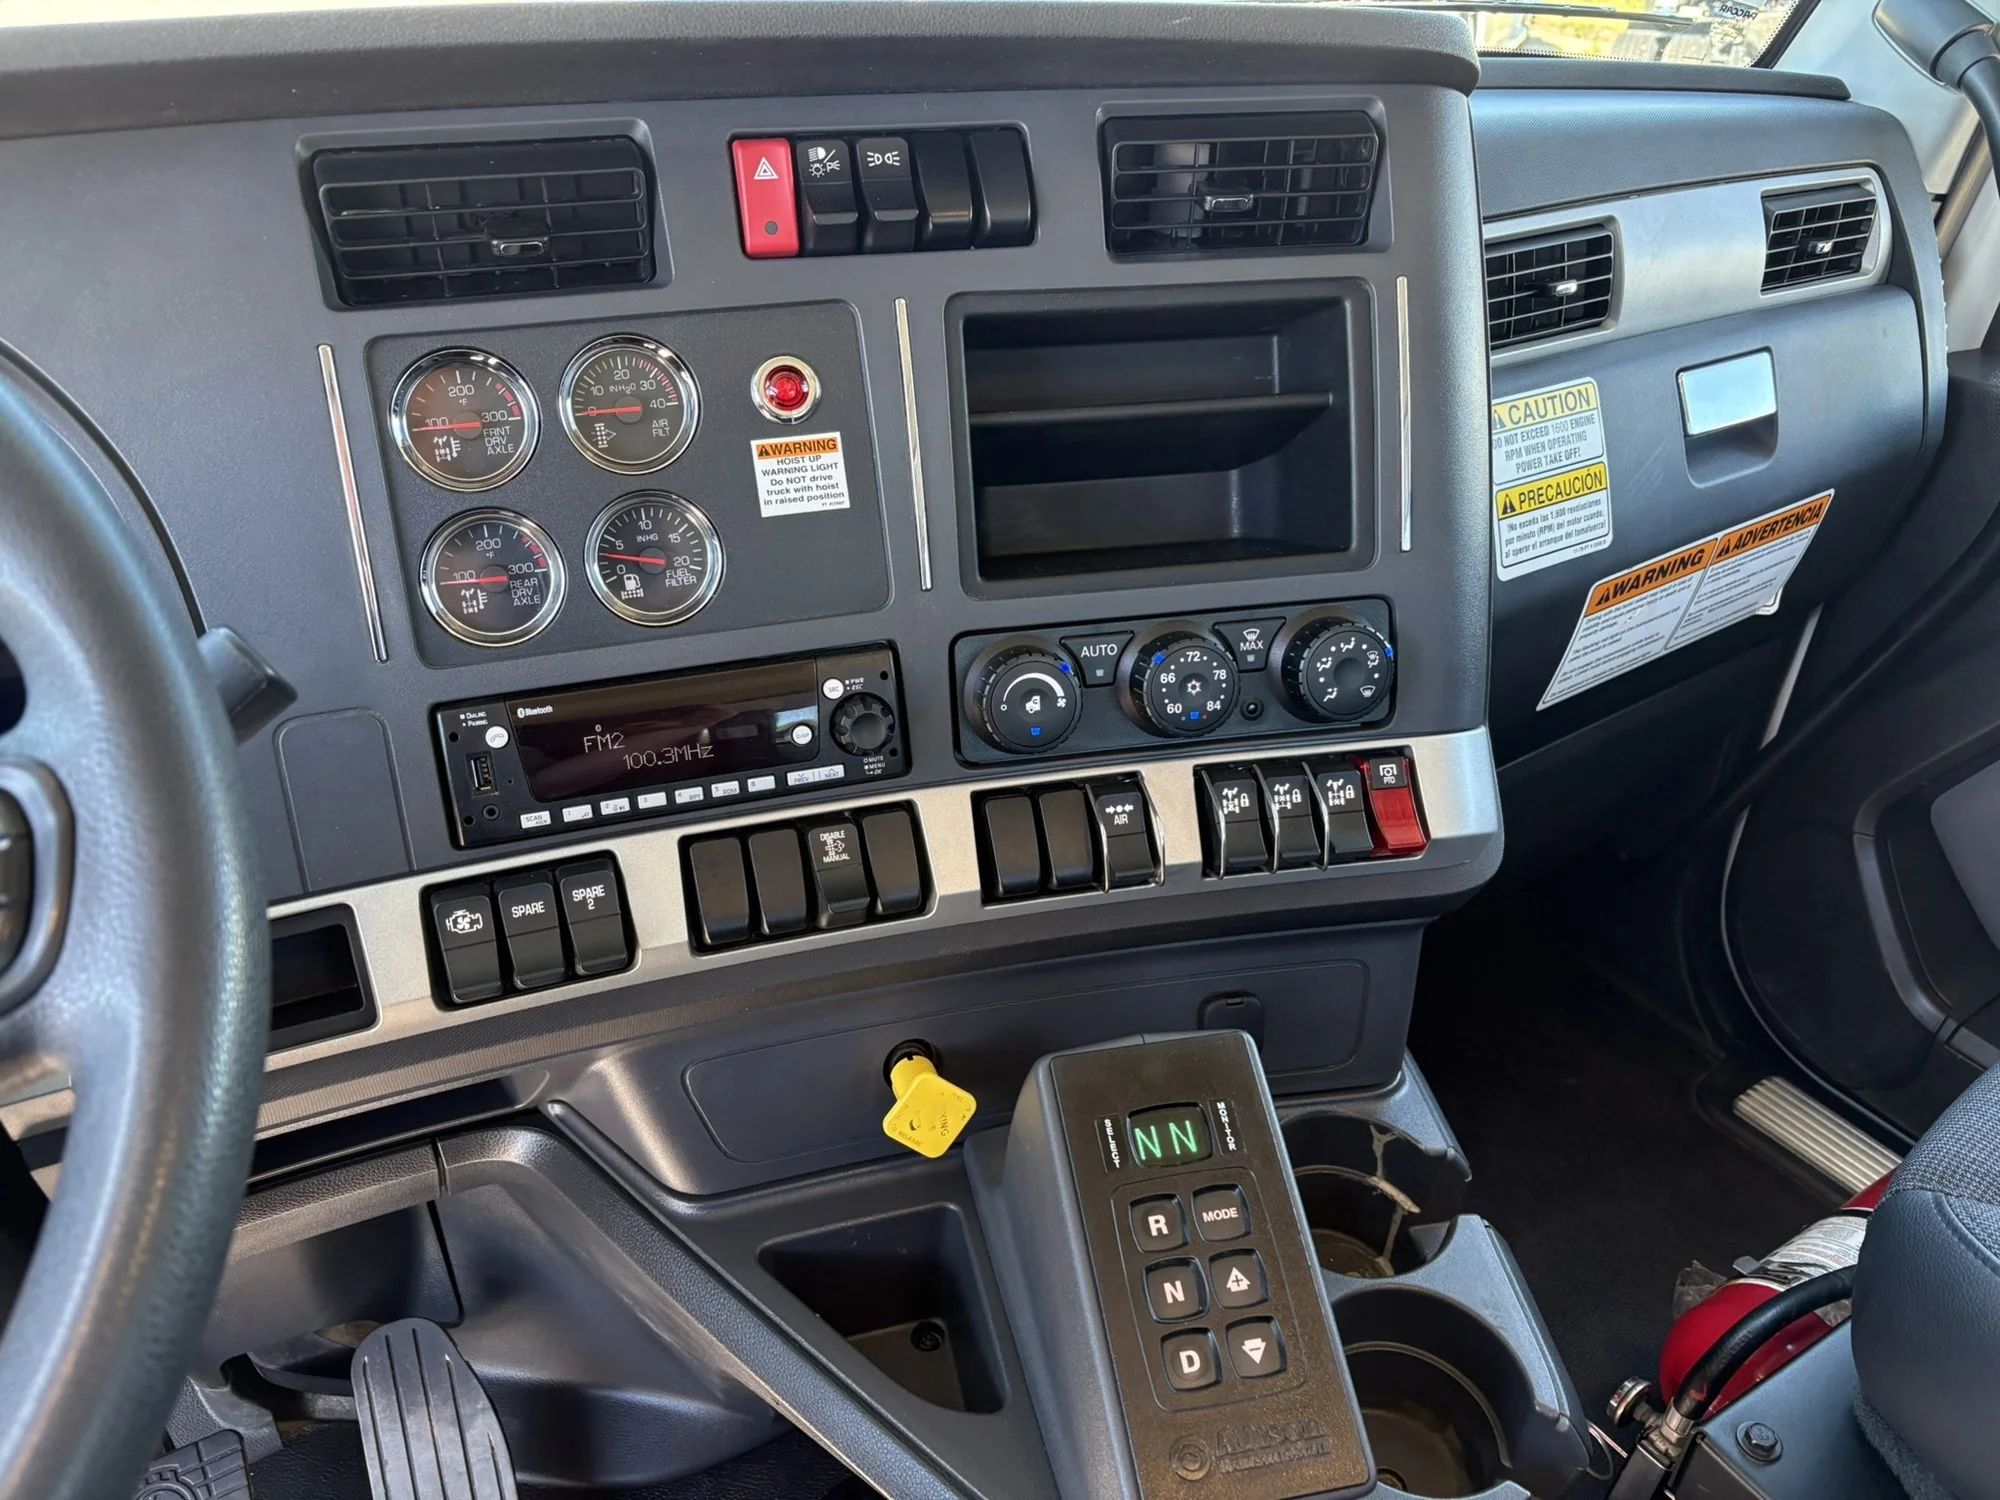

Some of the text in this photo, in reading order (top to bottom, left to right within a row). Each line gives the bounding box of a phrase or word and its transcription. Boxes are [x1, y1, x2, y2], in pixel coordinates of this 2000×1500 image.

[614, 369, 630, 381] 20
[447, 384, 475, 397] 200
[590, 385, 604, 396] 10
[640, 380, 656, 391] 30
[649, 398, 666, 409] 40
[1507, 386, 1591, 426] CAUTION
[425, 416, 449, 427] 100
[481, 410, 508, 423] 300
[652, 419, 669, 428] AIR
[483, 426, 511, 437] FRNT
[652, 427, 671, 437] FILT
[1504, 432, 1519, 447] NOT
[1521, 425, 1549, 442] EXCEED
[1570, 413, 1596, 430] ENGINE
[484, 436, 508, 447] DRV
[769, 438, 837, 456] WARNING
[1504, 430, 1587, 462] RPM WHEN OPERATING
[486, 444, 515, 456] AXLE
[776, 455, 822, 466] HOIST UP
[1516, 447, 1581, 474] POWER TAKE OFF!
[761, 462, 839, 477] WARNING LIGHT
[770, 474, 834, 487] Do NOT drive
[766, 482, 840, 496] truck with hoist
[1518, 469, 1603, 510] PRECAUCIÓN
[763, 491, 845, 506] in raised position
[1519, 516, 1539, 529] exceda
[1540, 513, 1549, 523] las
[1567, 499, 1601, 514] revoluciones
[638, 519, 652, 531] 10
[1730, 502, 1824, 553] ADVERTENCIA
[668, 532, 681, 544] 15
[1505, 537, 1515, 548] por
[1516, 530, 1536, 543] minuto
[1537, 523, 1555, 538] (RPM)
[1556, 520, 1565, 530] del
[1566, 516, 1582, 527] motor
[475, 538, 502, 551] 200
[615, 540, 624, 550] 5
[1505, 549, 1510, 559] al
[1512, 544, 1531, 557] operar
[1532, 540, 1538, 550] el
[1539, 535, 1563, 548] arranque
[1565, 529, 1573, 540] del
[673, 555, 690, 567] 20
[508, 562, 534, 575] 300
[616, 564, 626, 575] 0
[666, 568, 691, 578] FUEL
[1610, 549, 1705, 600] WARNING
[453, 570, 476, 581] 100
[510, 578, 539, 588] REAR
[665, 576, 697, 588] FILTER
[511, 587, 533, 598] DRV
[513, 595, 541, 607] AXLE
[1080, 643, 1118, 658] AUTO
[1239, 640, 1264, 652] MAX
[1186, 651, 1201, 662] 72
[1159, 672, 1176, 685] 66
[1213, 669, 1227, 680] 78
[525, 705, 553, 716] Bluetooth
[1166, 702, 1183, 715] 60
[1206, 700, 1221, 712] 84
[583, 732, 626, 753] FM2
[622, 743, 714, 770] 100.3MHz
[794, 776, 809, 784] PREV
[825, 771, 840, 779] NEXT
[1383, 776, 1396, 784] PTO
[525, 814, 543, 823] SCAN
[1114, 813, 1129, 827] AIR
[820, 830, 845, 841] DISABLE
[823, 853, 850, 863] MANUAL
[572, 884, 605, 902] SPARE
[511, 901, 545, 918] SPARE
[587, 898, 595, 910] 2
[1216, 1101, 1236, 1151] MONITOR
[1104, 1119, 1120, 1168] SELECT
[1134, 1120, 1198, 1161] N N
[1202, 1207, 1239, 1222] MODE
[1148, 1214, 1168, 1237] R
[1164, 1280, 1185, 1303] N
[1180, 1350, 1201, 1374] D
